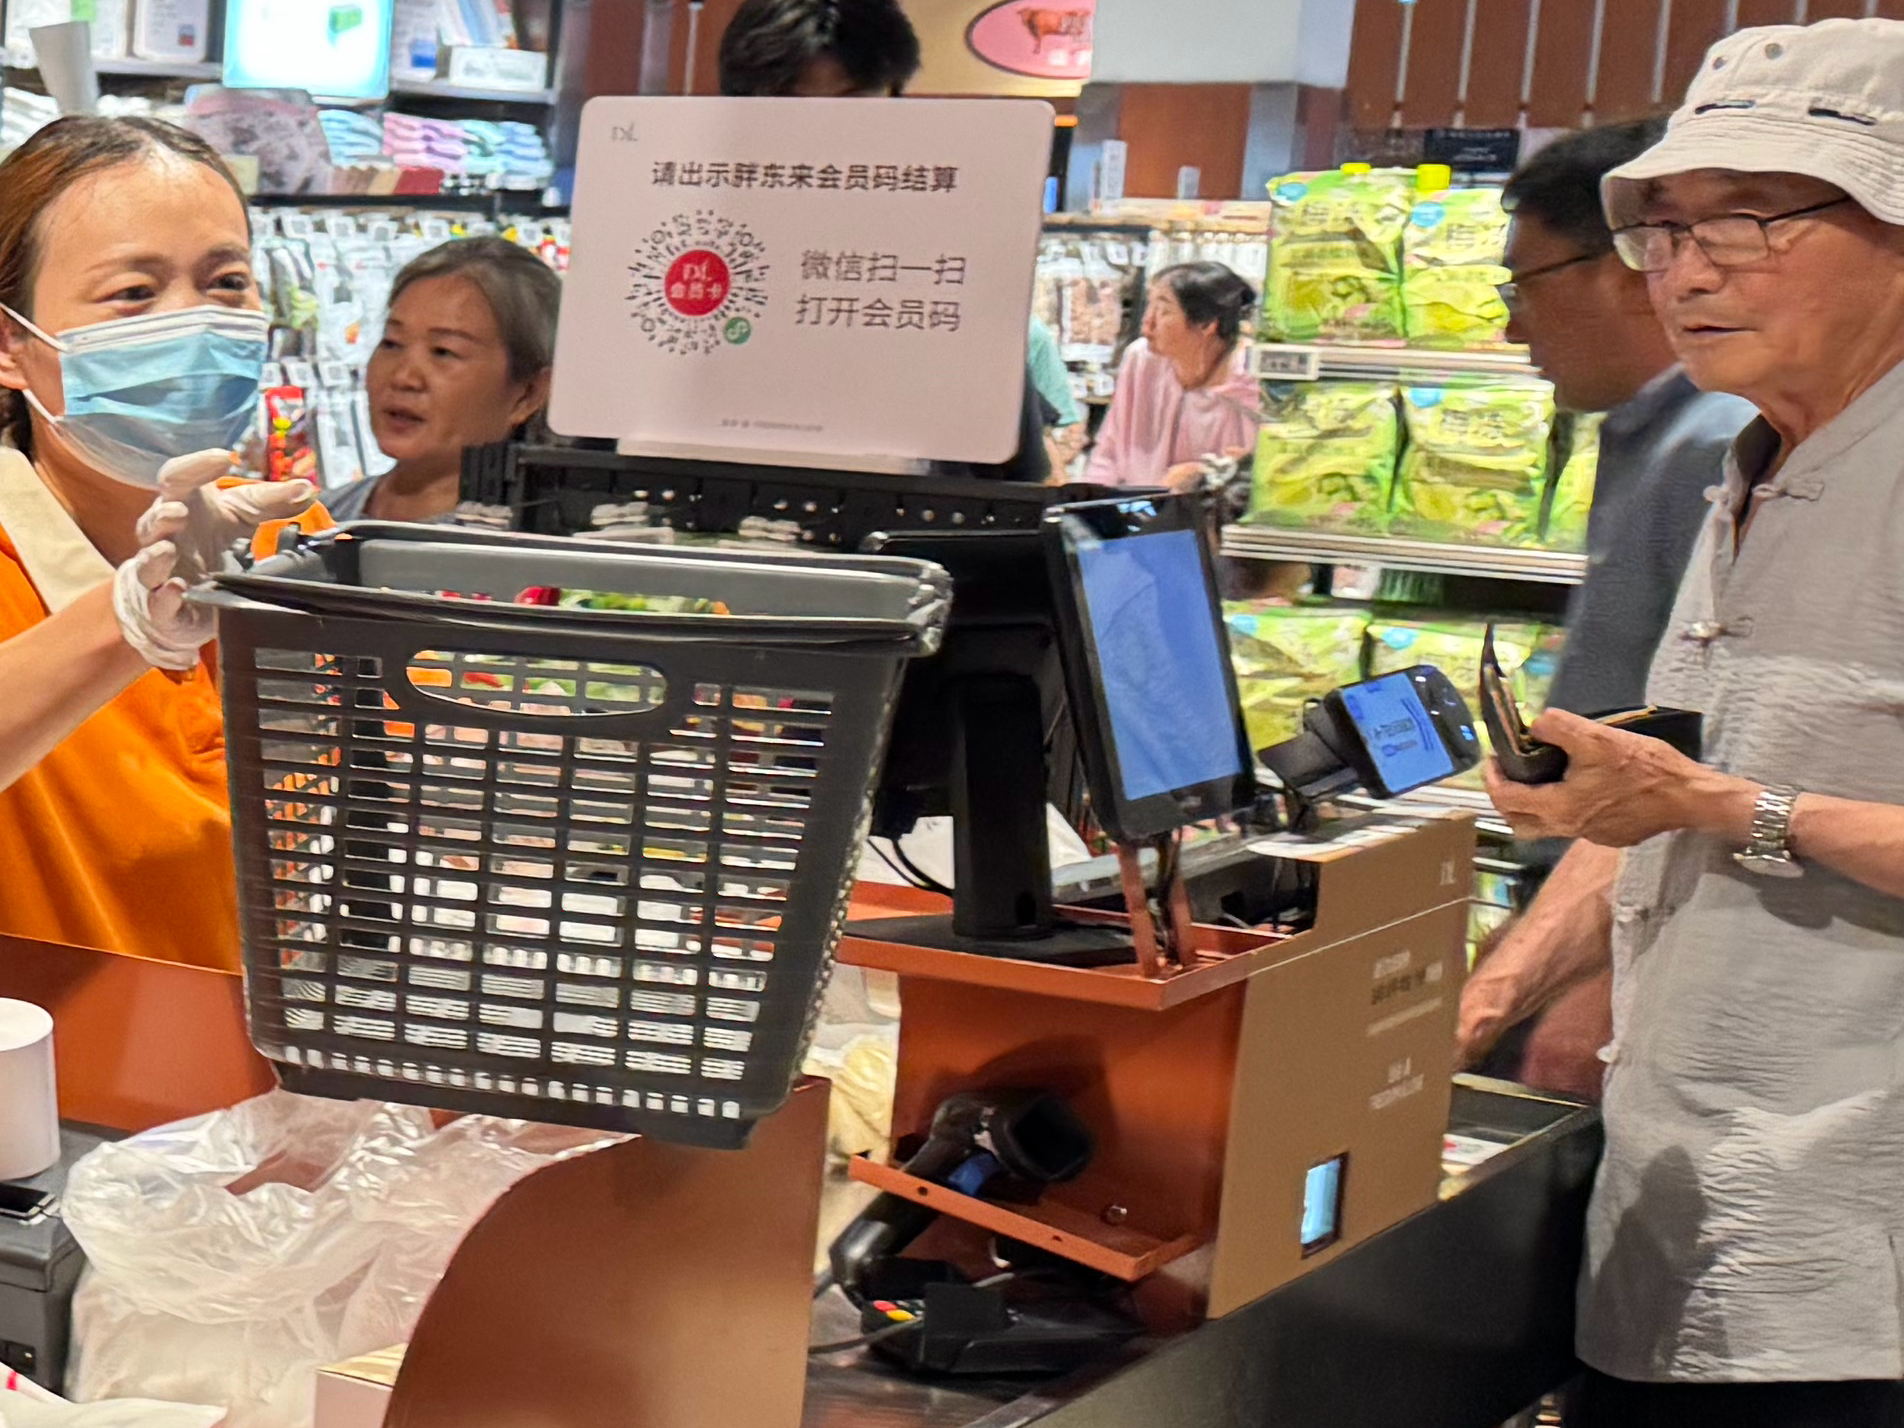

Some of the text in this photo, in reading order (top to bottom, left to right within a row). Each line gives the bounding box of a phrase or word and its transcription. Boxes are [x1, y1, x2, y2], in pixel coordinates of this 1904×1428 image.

[651, 162, 959, 193] 请出示胖东来会员码结算
[800, 249, 968, 286] 微信扫一扫
[794, 294, 961, 332] 打开会员码
